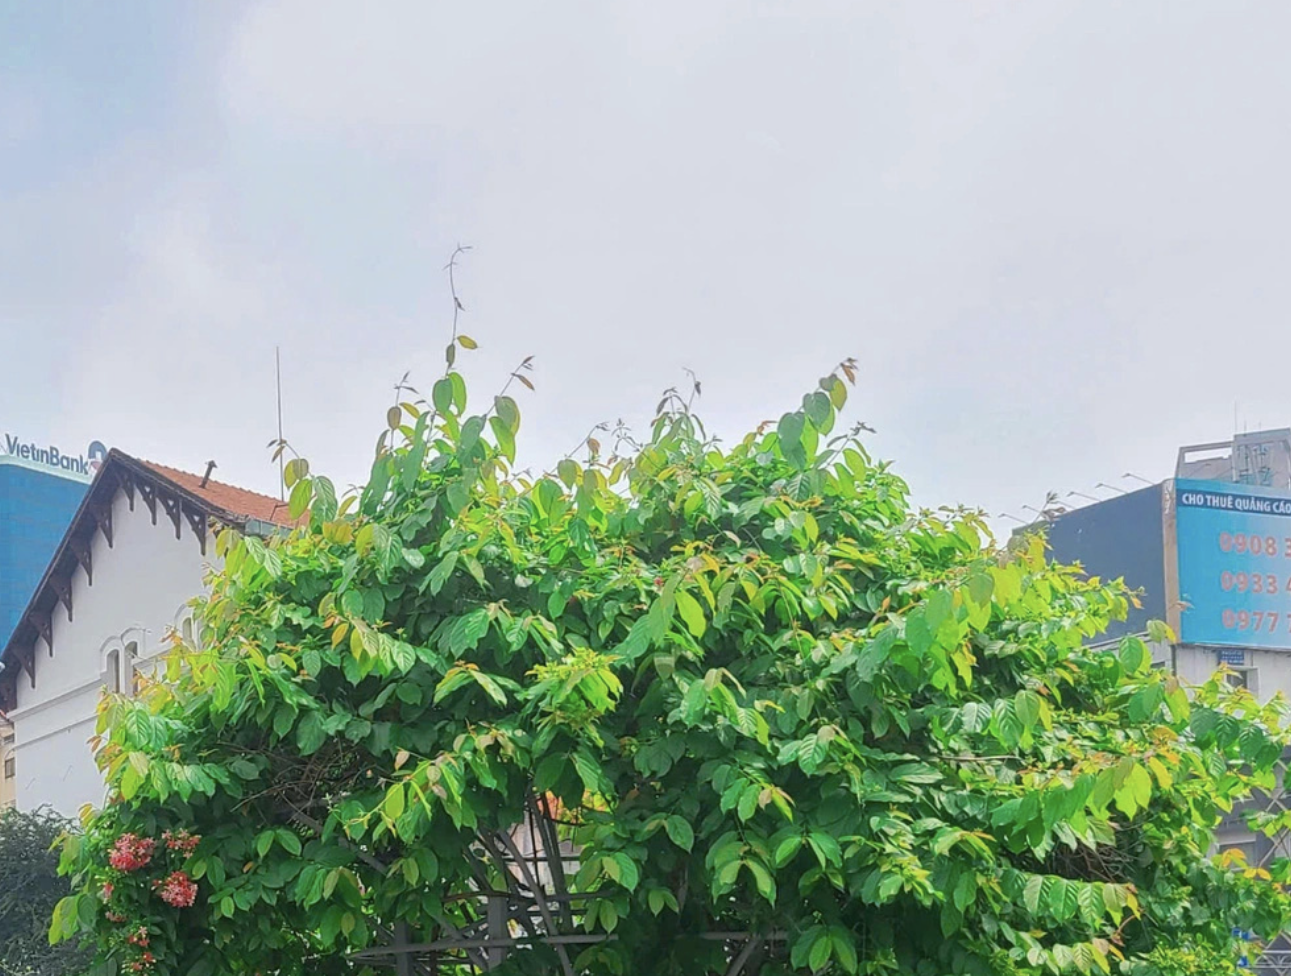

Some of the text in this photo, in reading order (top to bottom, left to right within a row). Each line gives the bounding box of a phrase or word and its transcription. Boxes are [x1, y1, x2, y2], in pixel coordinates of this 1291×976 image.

[5, 433, 89, 475] VietinBank
[1182, 492, 1291, 514] CHO THUÊ QUẢNG CÁO
[1220, 532, 1277, 557] 0908
[1221, 571, 1278, 595] 0933
[1222, 608, 1279, 633] 0977
